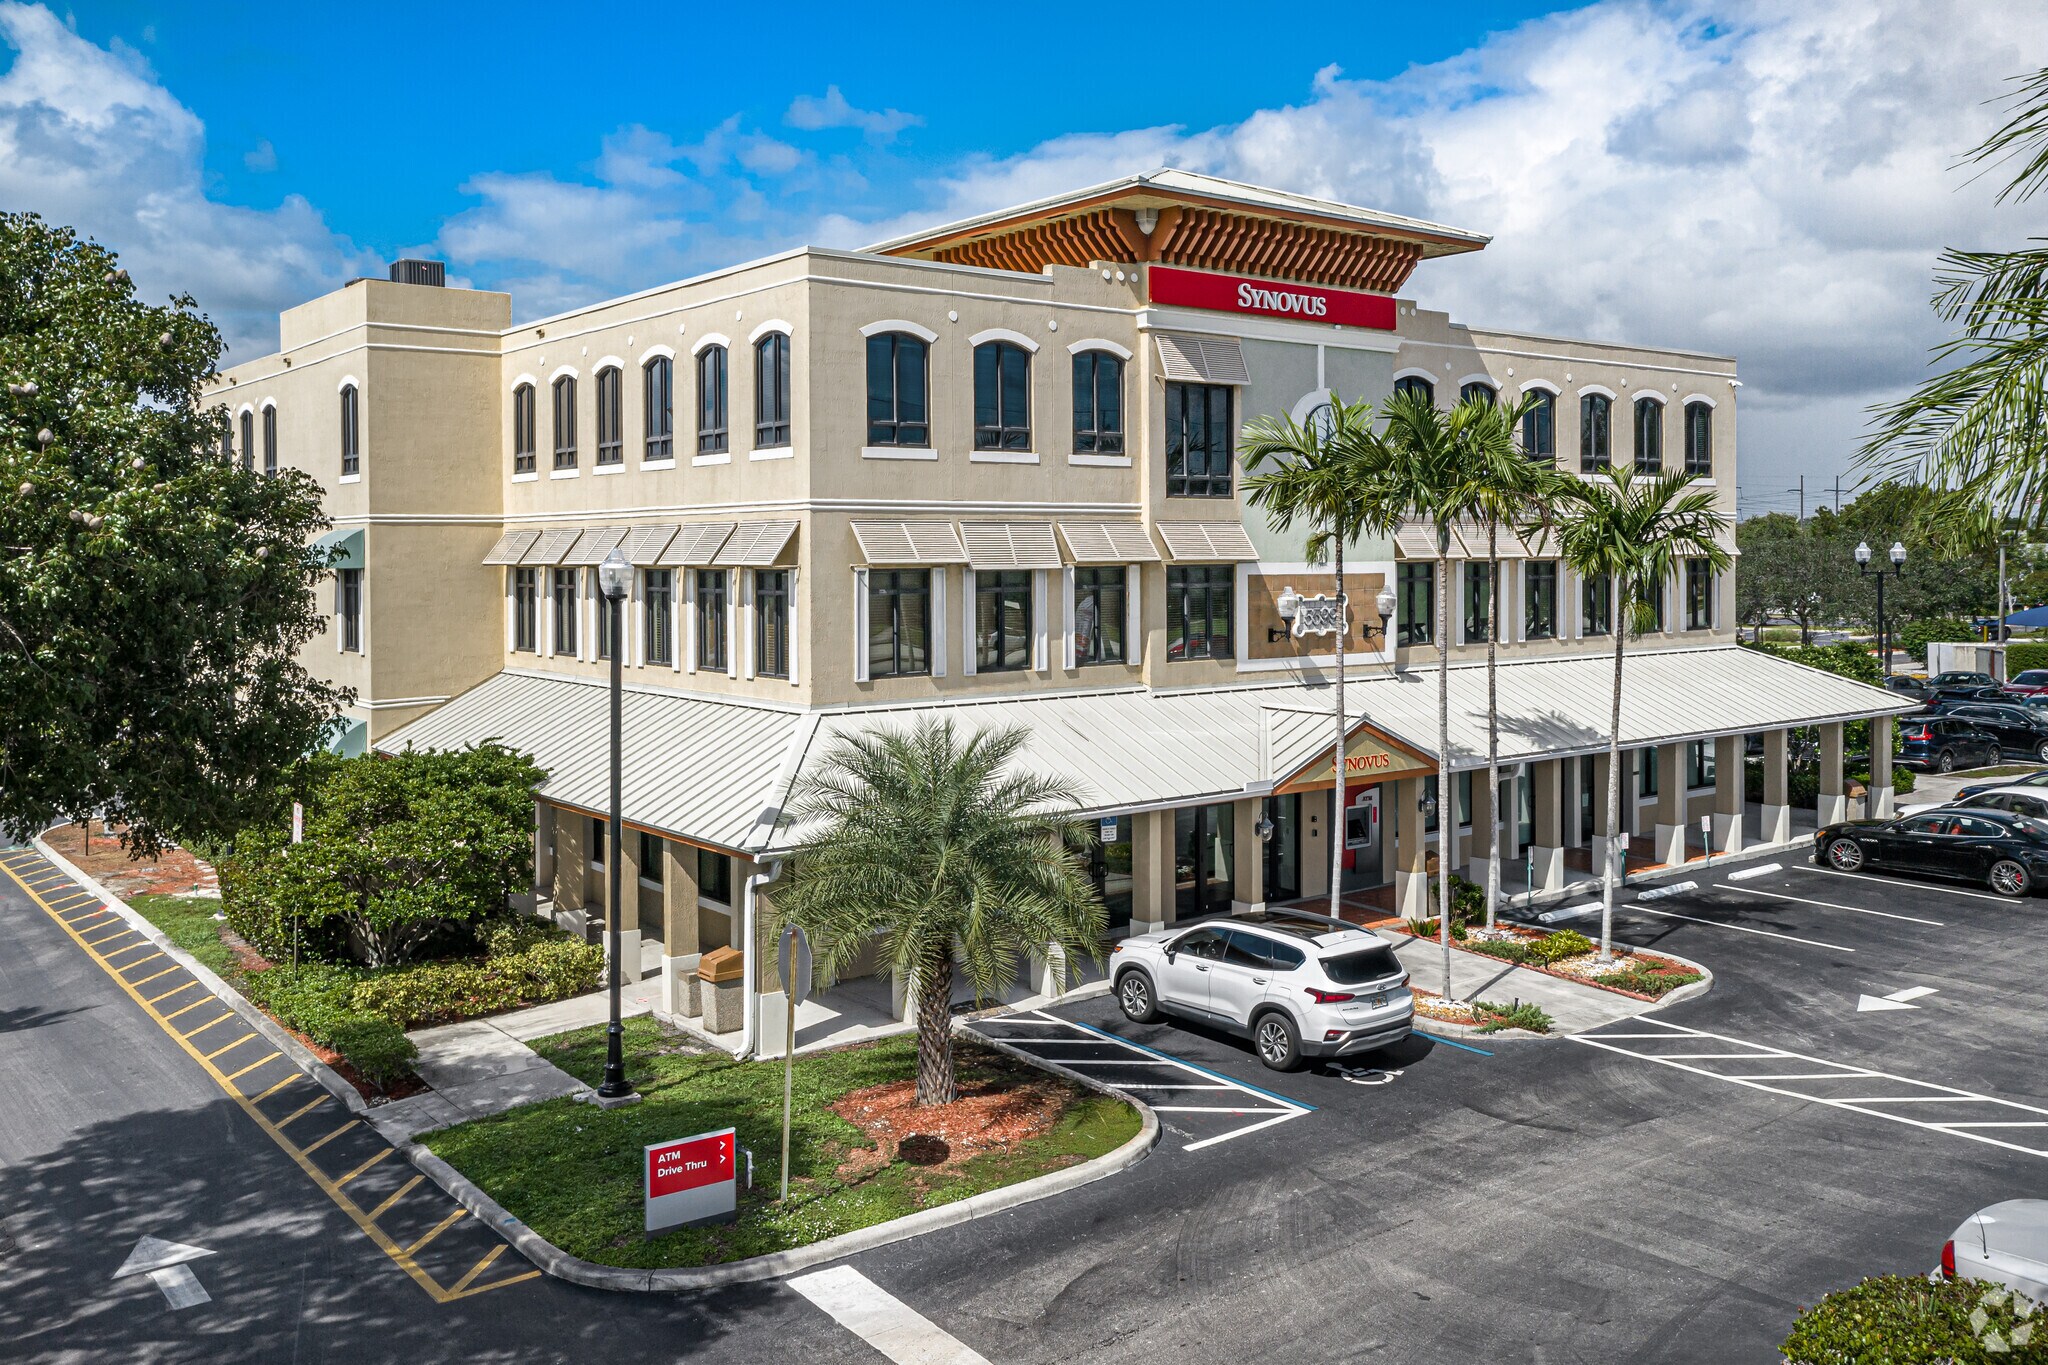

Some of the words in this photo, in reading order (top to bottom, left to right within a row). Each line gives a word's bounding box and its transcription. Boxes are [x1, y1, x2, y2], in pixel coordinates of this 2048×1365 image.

[1237, 282, 1327, 317] SYNOVUS
[657, 1150, 681, 1164] ATM
[657, 1165, 683, 1178] Drive
[685, 1160, 707, 1171] Thru
